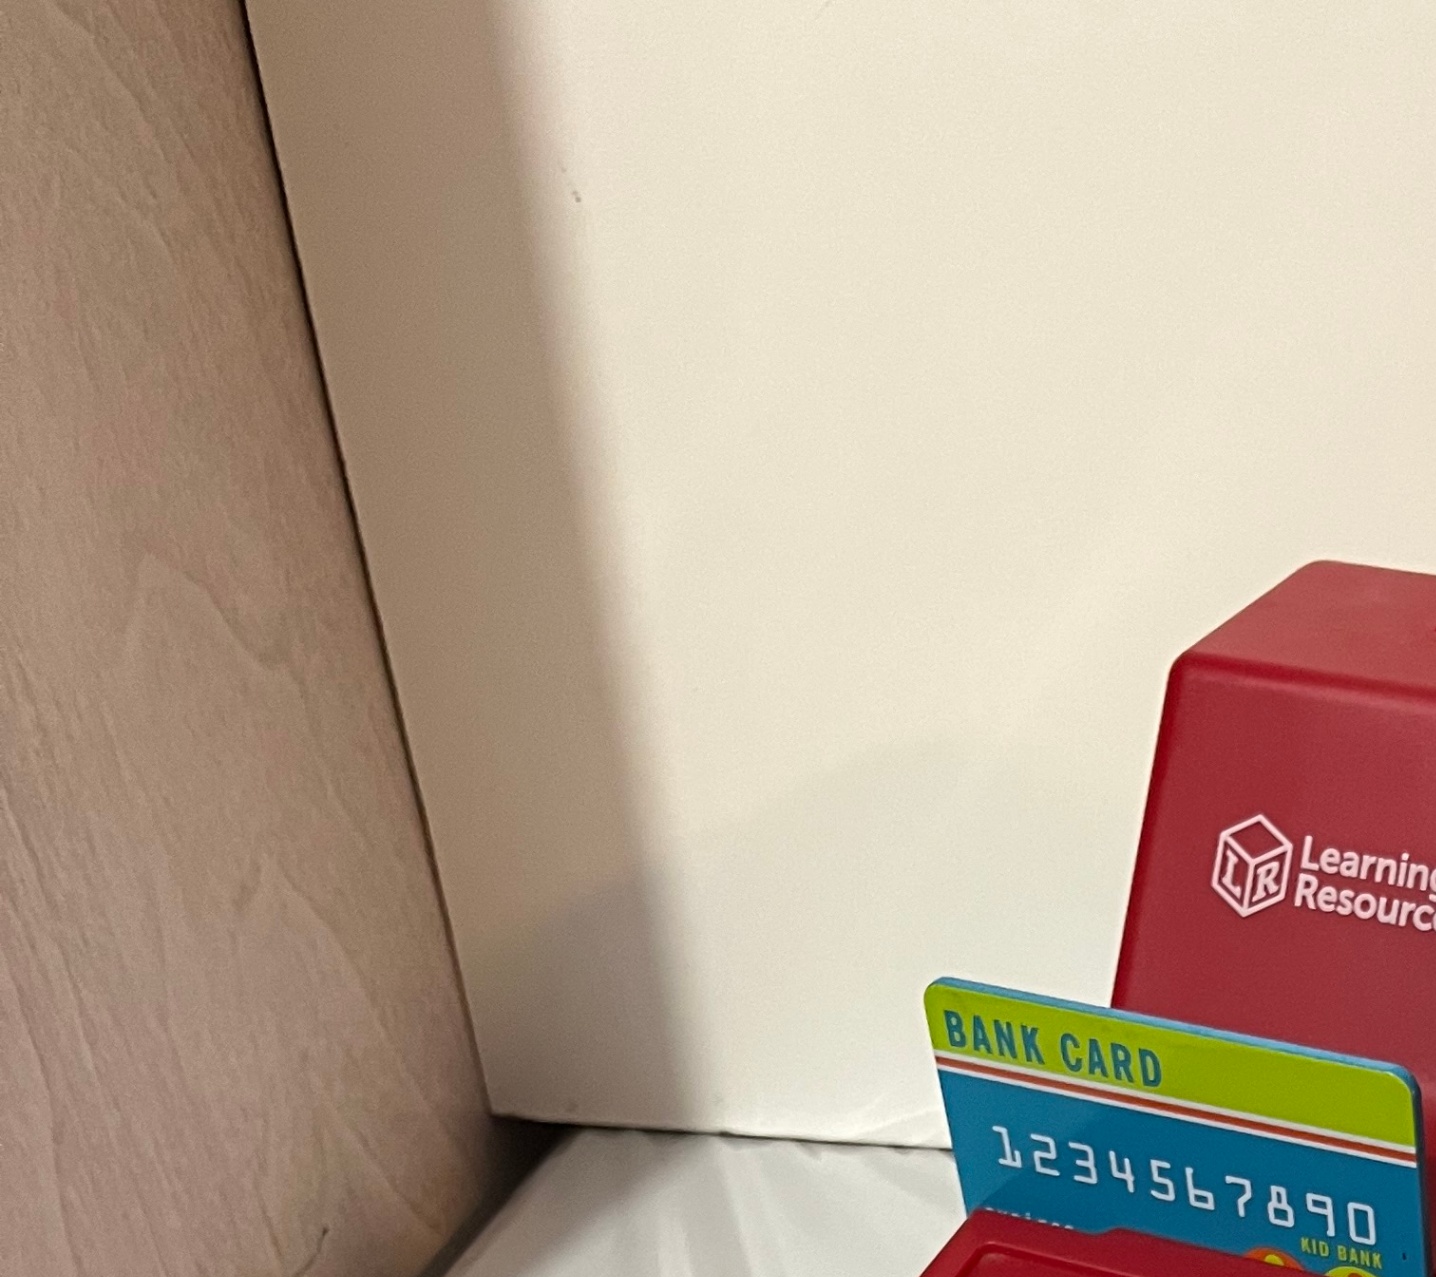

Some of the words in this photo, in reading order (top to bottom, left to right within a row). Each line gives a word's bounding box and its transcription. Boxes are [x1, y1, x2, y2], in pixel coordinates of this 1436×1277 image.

[943, 1009, 1045, 1066] BANK
[1060, 1032, 1163, 1088] CARD
[991, 1125, 1378, 1247] 1234567890
[1301, 1236, 1330, 1258] KID
[1337, 1247, 1384, 1270] BANK
